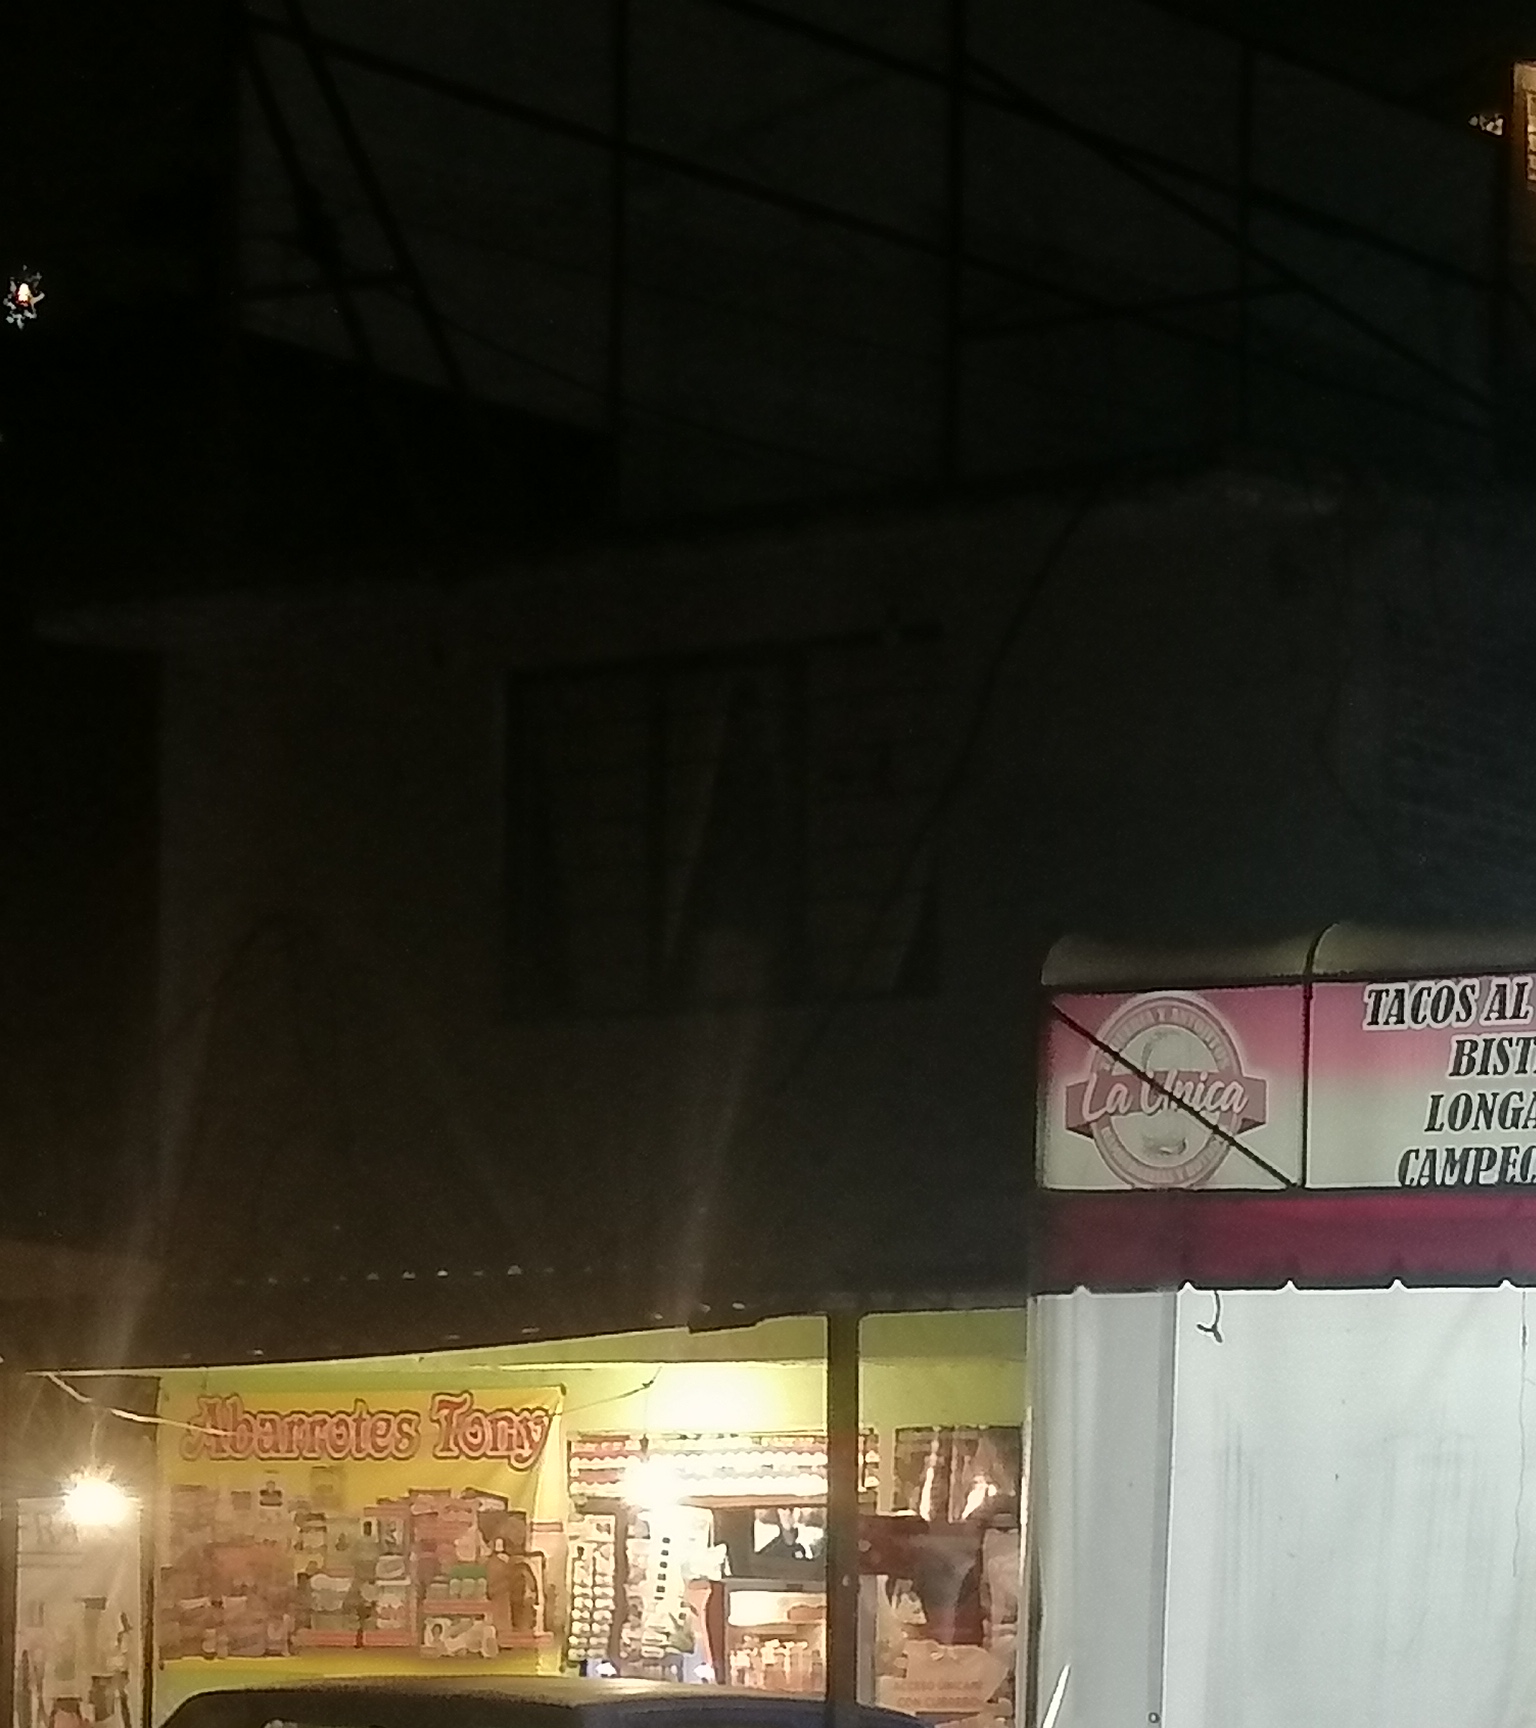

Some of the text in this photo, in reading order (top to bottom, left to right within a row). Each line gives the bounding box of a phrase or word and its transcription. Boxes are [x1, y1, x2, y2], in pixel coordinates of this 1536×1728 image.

[1366, 981, 1476, 1028] TACOS
[1483, 979, 1530, 1023] AL
[1081, 1071, 1132, 1123] La
[430, 1391, 551, 1472] Tony
